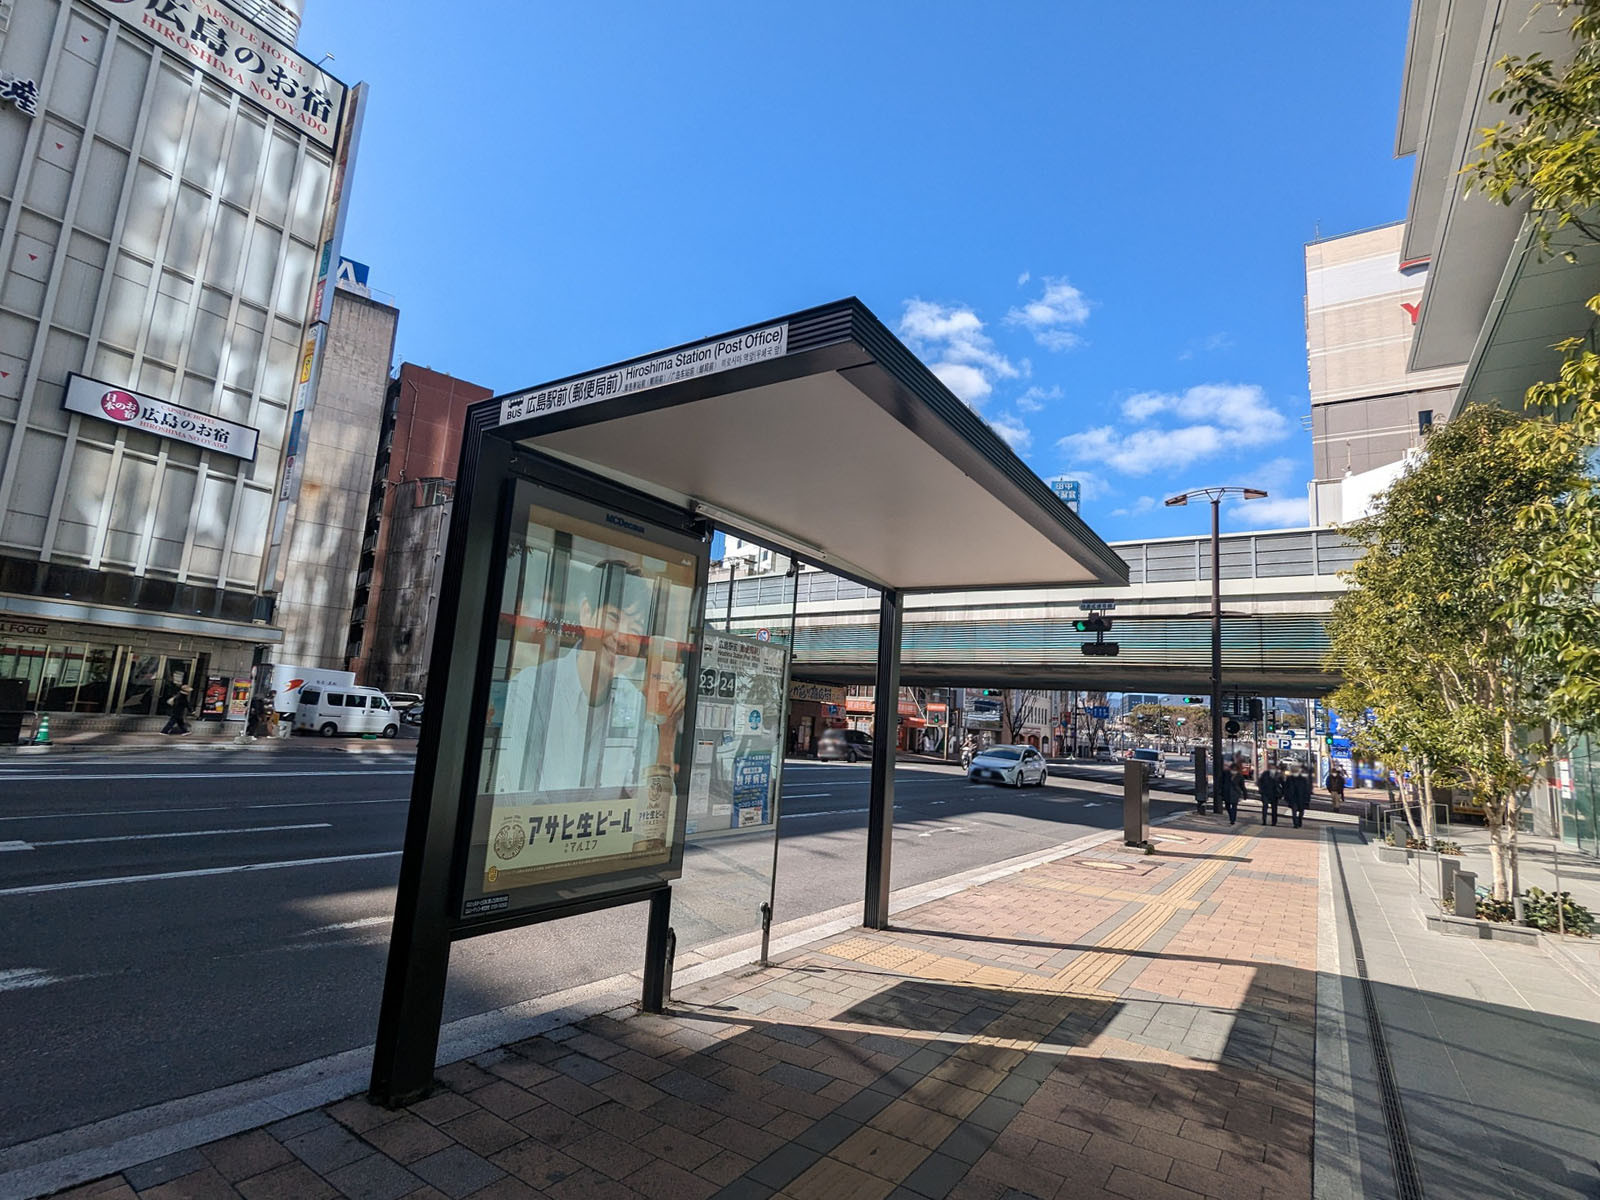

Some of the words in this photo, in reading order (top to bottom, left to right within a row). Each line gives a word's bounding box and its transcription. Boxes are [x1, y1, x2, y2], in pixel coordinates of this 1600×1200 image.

[142, 12, 245, 86] HIROSHIMA
[249, 79, 272, 101] NO
[275, 97, 328, 136] OYADO
[144, 0, 334, 124] 広島のお宿
[261, 40, 307, 77] HOTEL
[626, 359, 673, 381] Hiroshima
[675, 347, 712, 368] Station
[714, 338, 742, 360] (Post
[745, 326, 783, 349] Office)
[139, 420, 186, 439] HIROSHIMA
[188, 433, 200, 442] NO
[140, 406, 231, 444] 広島のお宿
[192, 413, 216, 426] HOTEL
[506, 408, 522, 420] BUS
[9, 623, 48, 635] FOCUS
[699, 674, 714, 689] 23
[720, 677, 734, 691] 24
[528, 808, 633, 846] アサヒ生ビール
